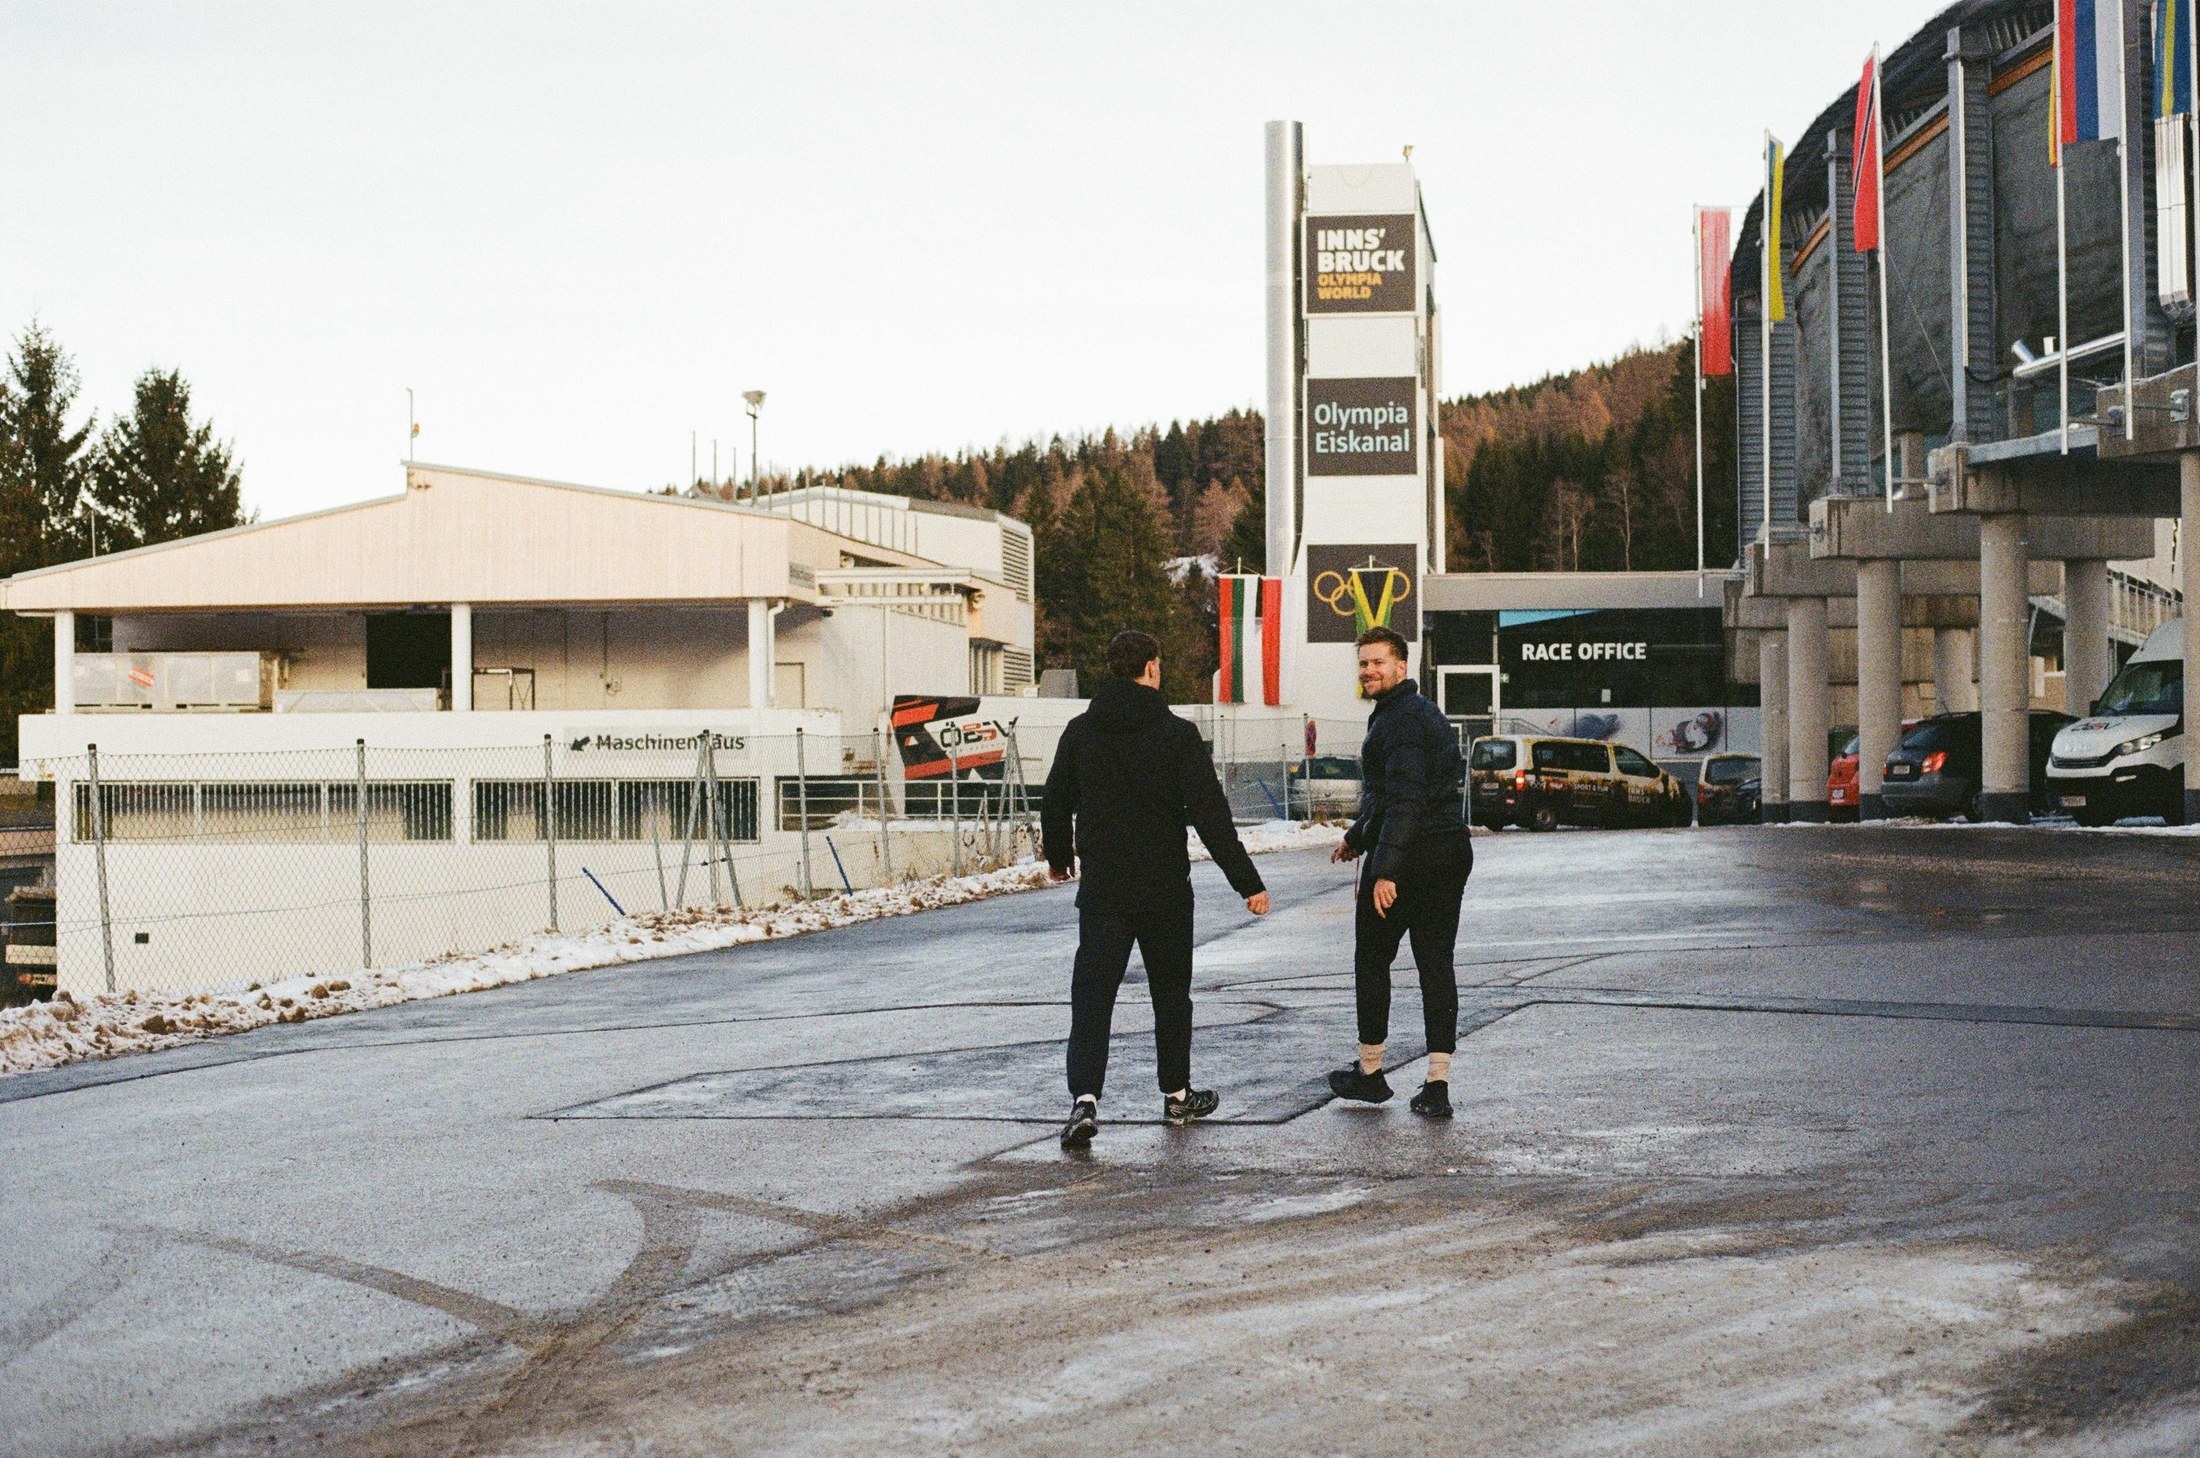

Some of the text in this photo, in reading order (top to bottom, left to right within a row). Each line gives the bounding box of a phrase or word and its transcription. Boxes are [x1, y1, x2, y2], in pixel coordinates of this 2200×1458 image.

[1317, 228, 1386, 251] INNS'
[1317, 250, 1405, 272] BRUCK
[1318, 272, 1383, 287] OLYMPIA
[1317, 286, 1372, 300] WORLD
[1314, 401, 1408, 431] Olympia
[1315, 428, 1410, 453] Eiskanal
[1522, 642, 1647, 661] RACE OFFICE
[596, 733, 745, 750] Maschinenaus
